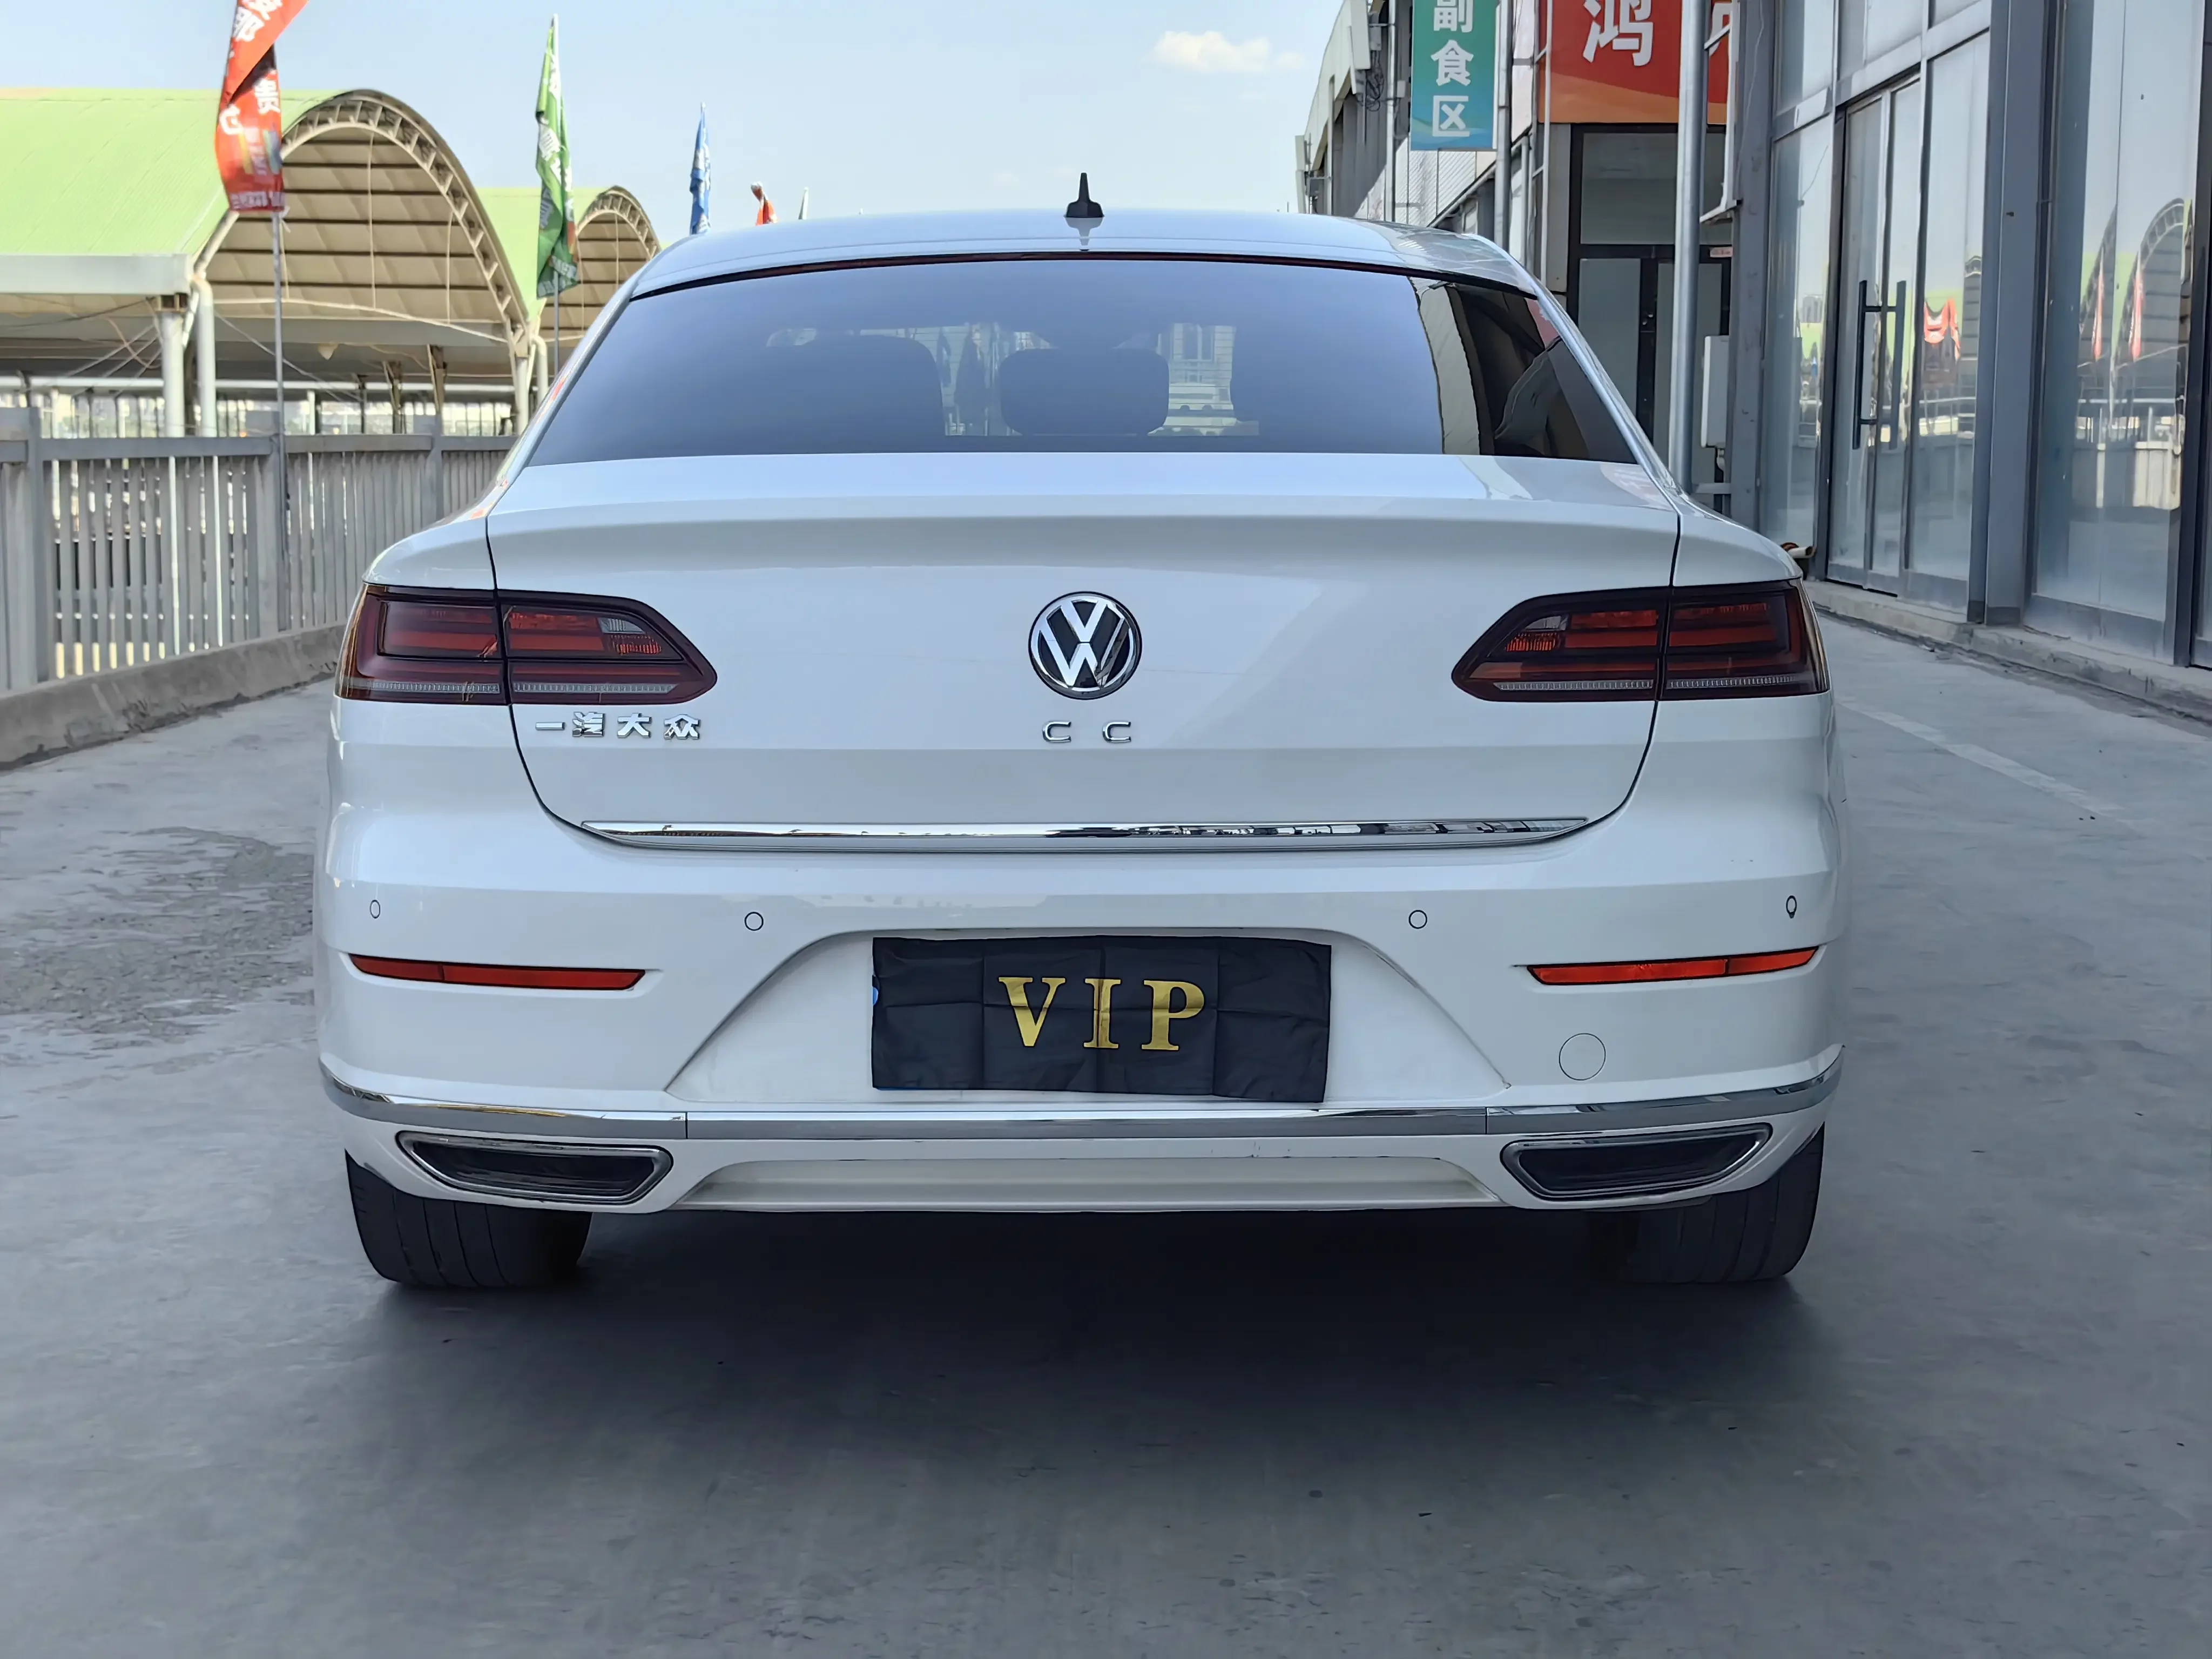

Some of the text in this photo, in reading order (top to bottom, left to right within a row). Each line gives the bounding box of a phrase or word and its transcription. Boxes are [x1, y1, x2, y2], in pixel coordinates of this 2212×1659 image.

[1430, 0, 1474, 137] 副食区
[997, 976, 1205, 1051] VIP
